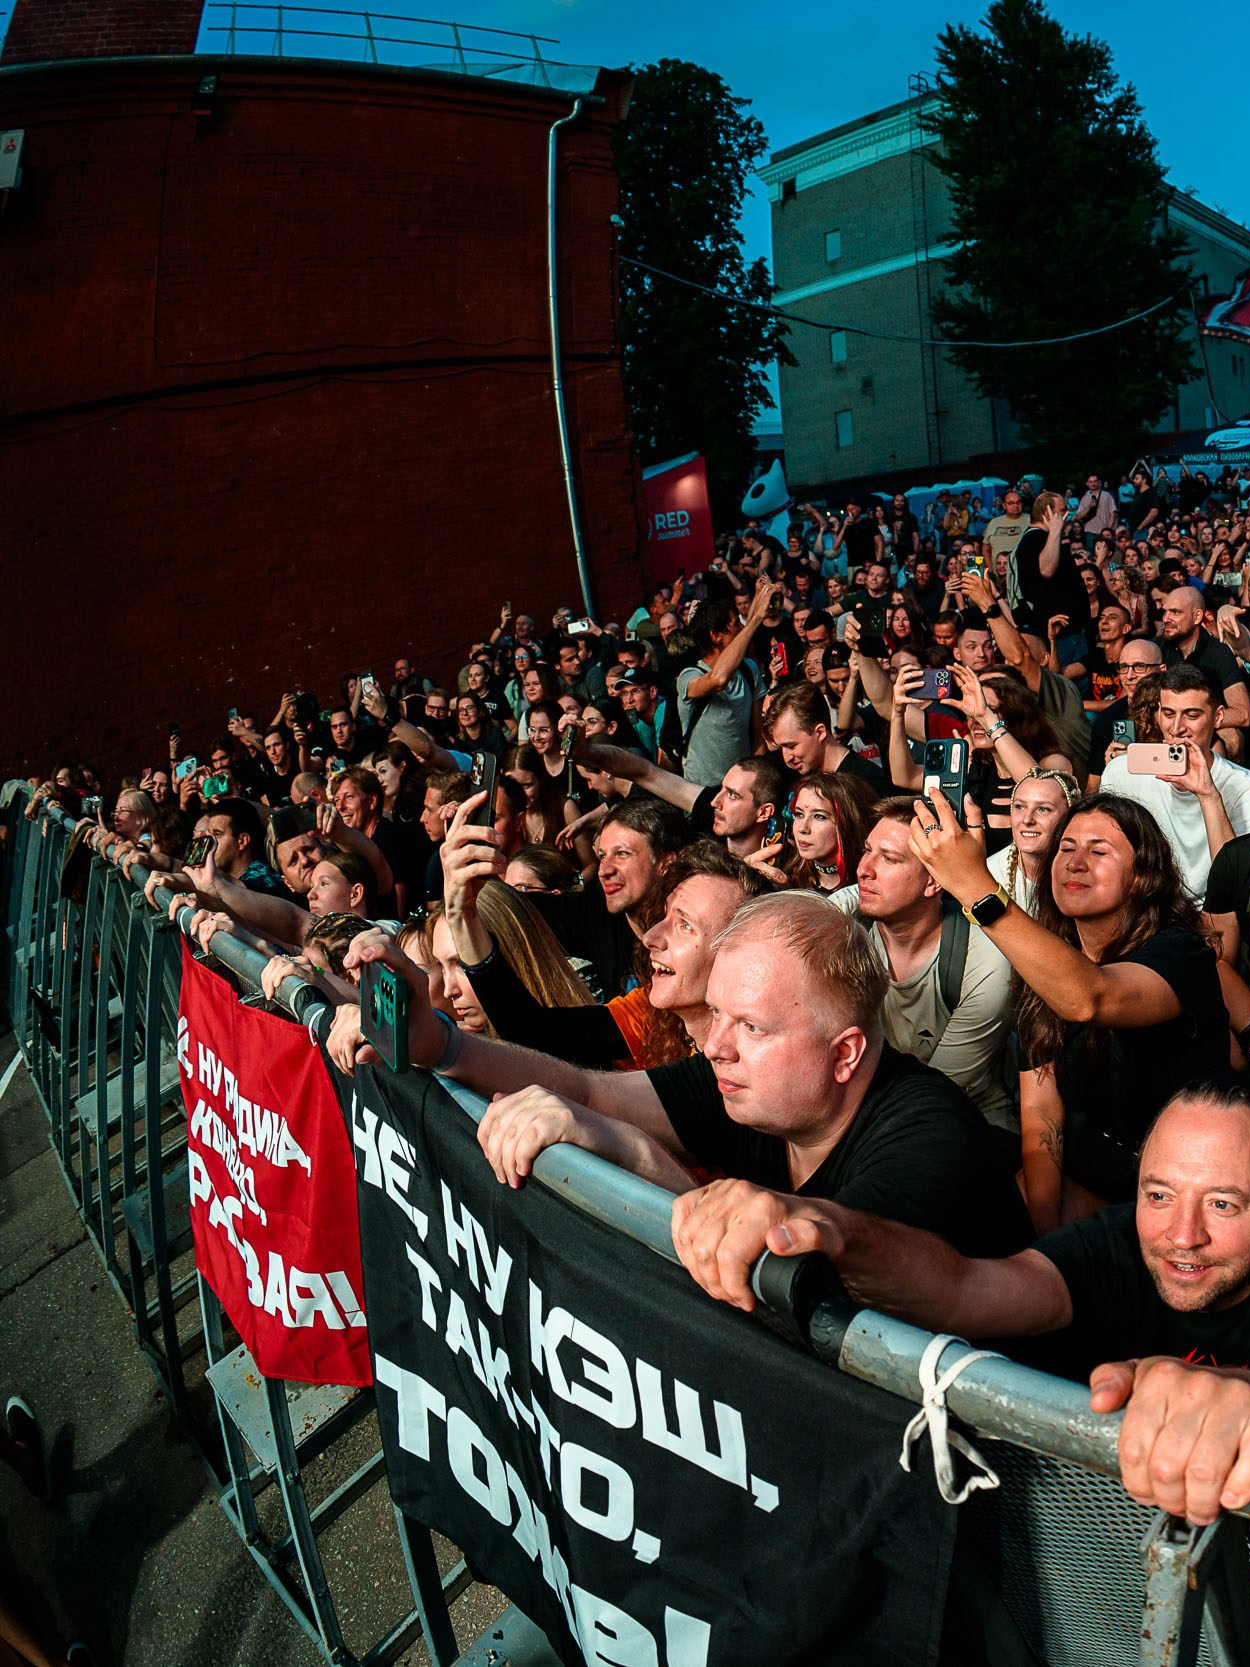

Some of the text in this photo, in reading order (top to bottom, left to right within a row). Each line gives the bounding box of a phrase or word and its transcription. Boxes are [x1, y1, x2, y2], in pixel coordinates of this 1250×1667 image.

[655, 510, 690, 530] RED
[197, 1041, 222, 1097] НУ
[441, 1179, 513, 1316] НУ
[529, 1277, 780, 1513] КЭШ,
